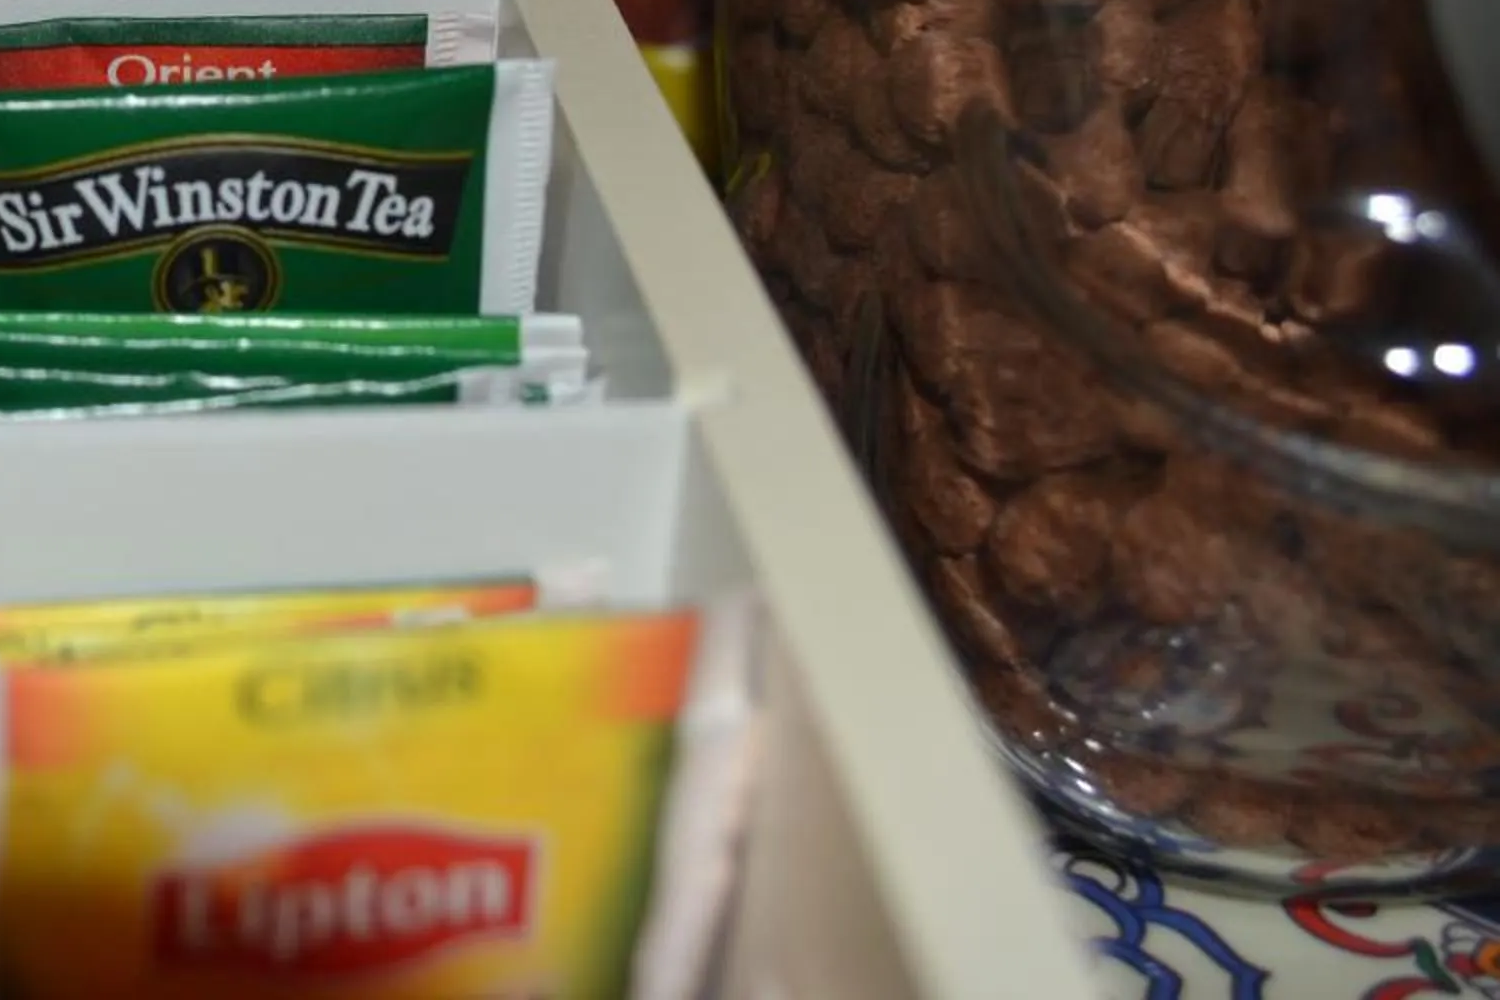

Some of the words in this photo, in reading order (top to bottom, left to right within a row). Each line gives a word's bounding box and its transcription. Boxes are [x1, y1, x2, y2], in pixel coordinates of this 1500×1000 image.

[75, 165, 342, 238] Winston
[345, 168, 435, 239] Tea
[180, 860, 510, 960] Lipton
